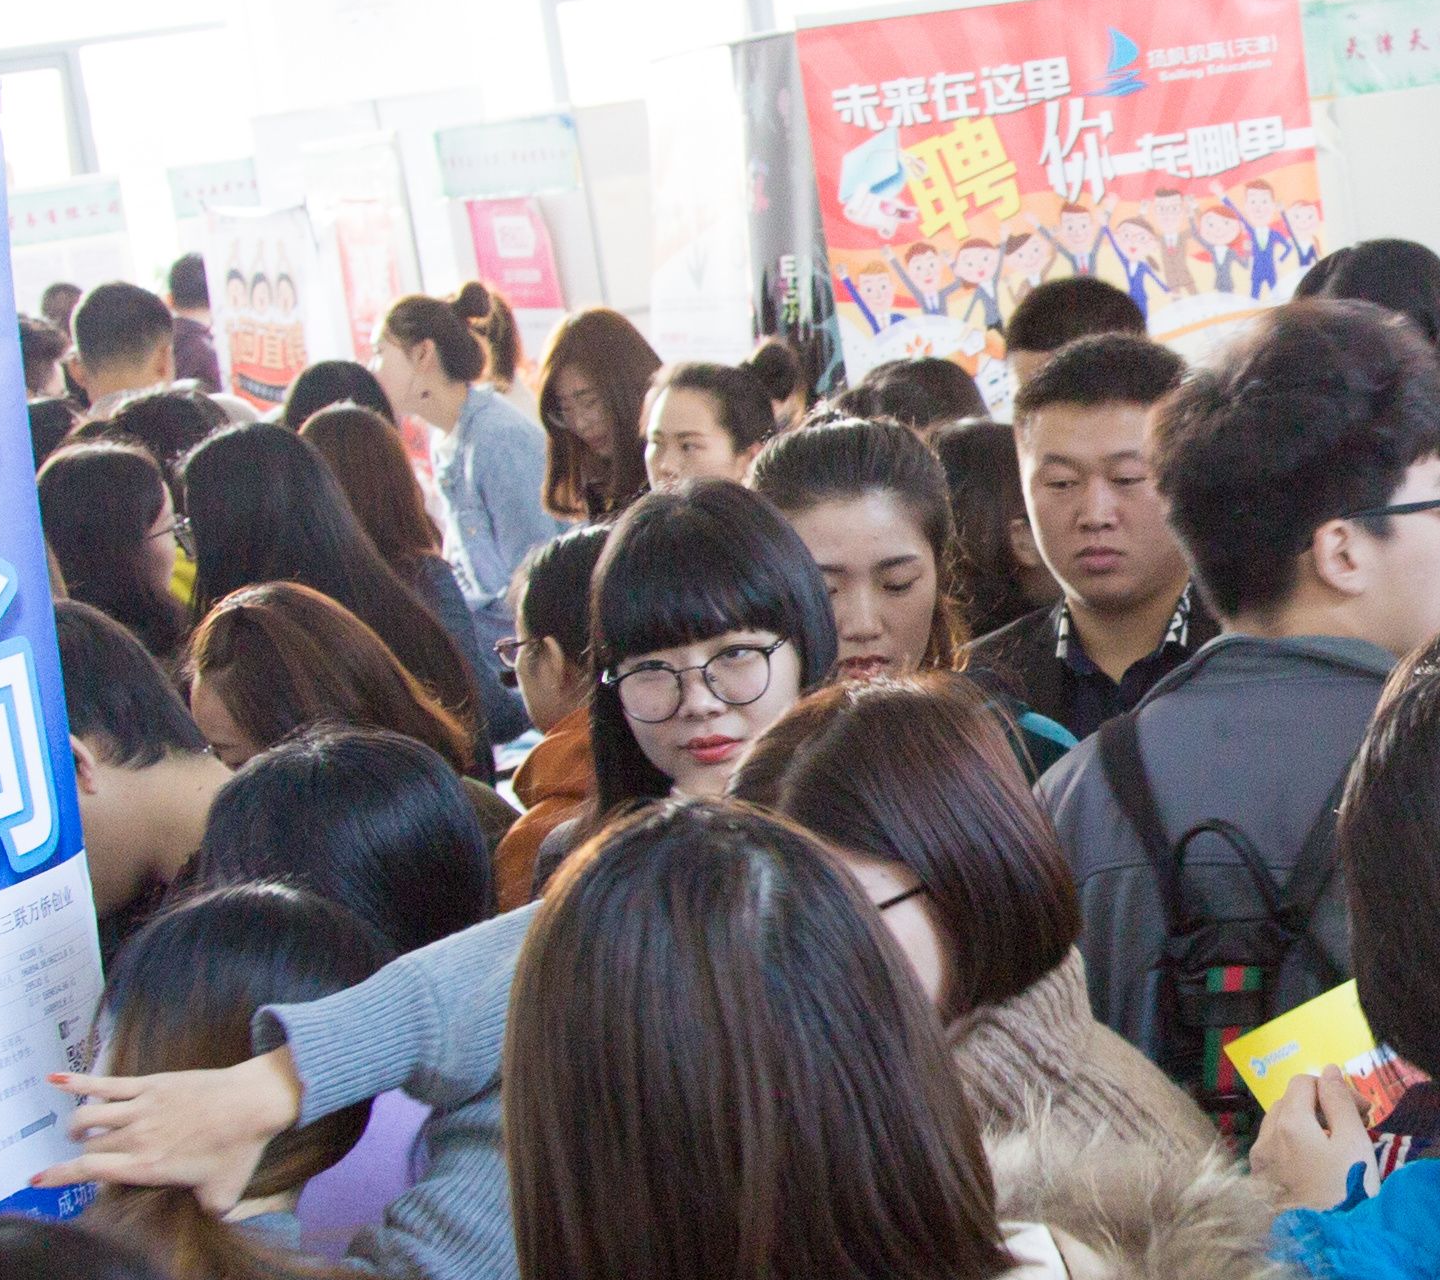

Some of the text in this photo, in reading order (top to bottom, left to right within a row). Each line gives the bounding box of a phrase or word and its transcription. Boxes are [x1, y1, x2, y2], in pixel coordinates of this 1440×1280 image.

[831, 55, 1071, 132] 未来在这里
[903, 115, 1022, 239] 聘
